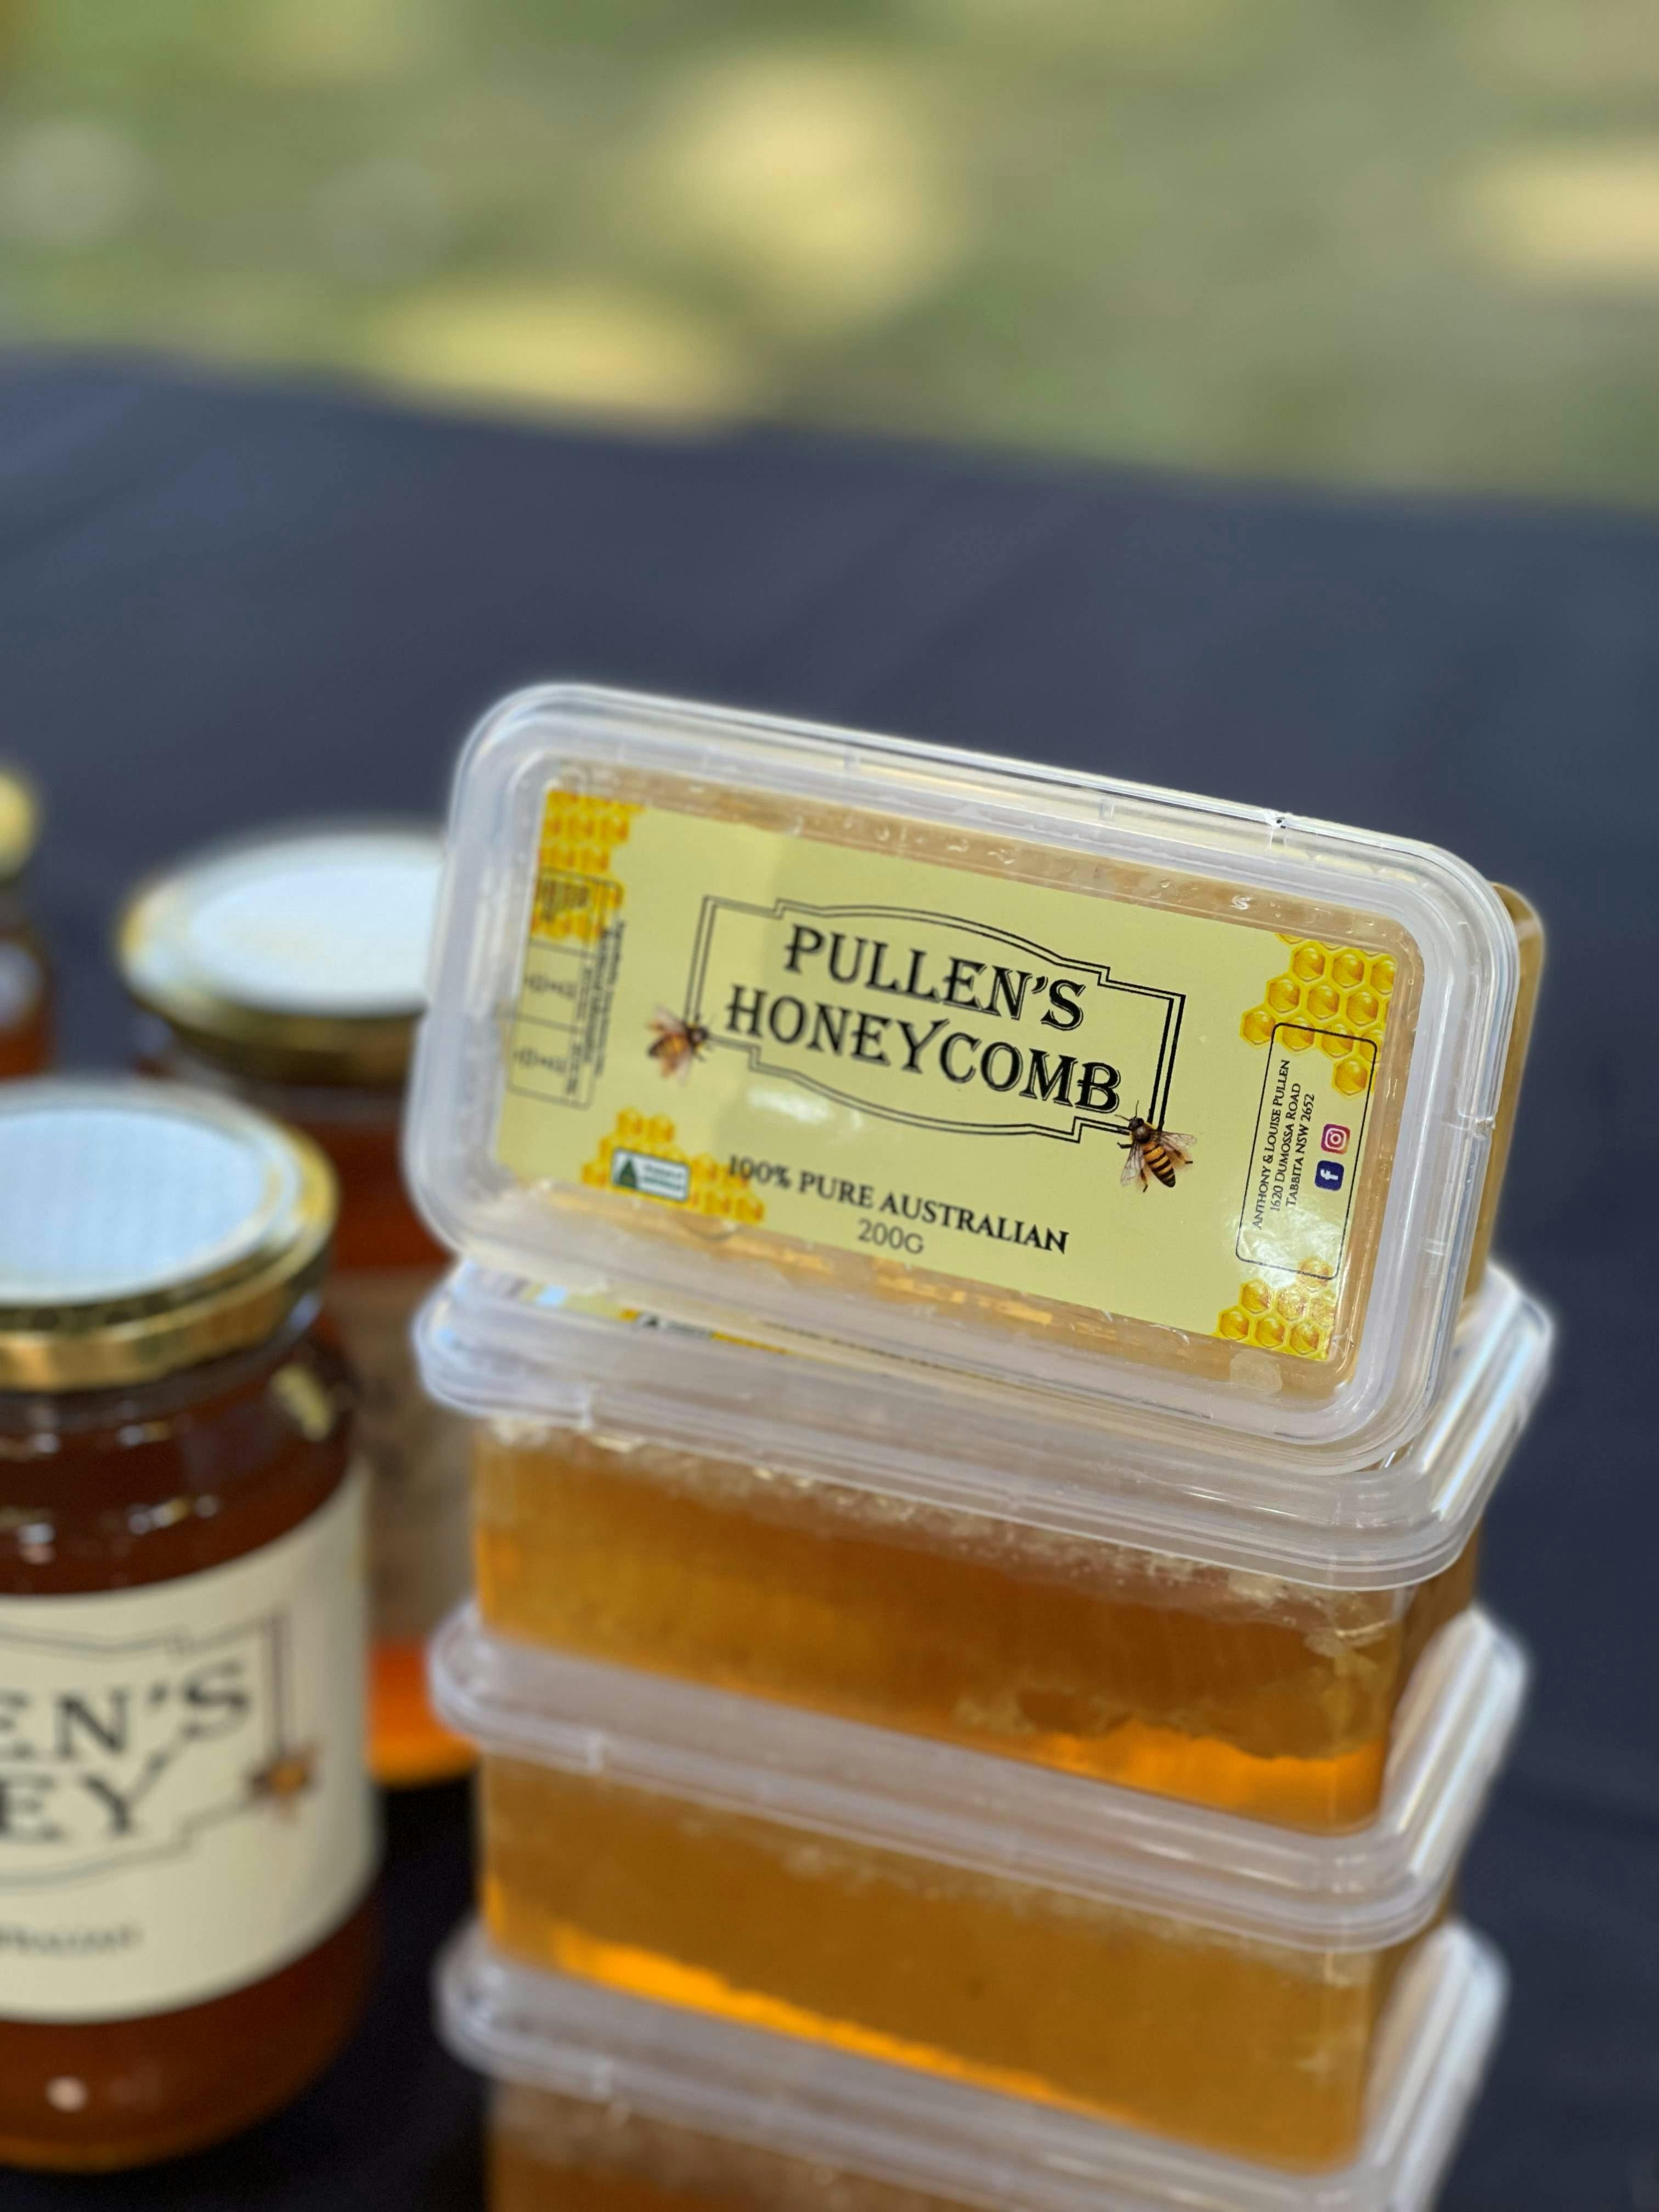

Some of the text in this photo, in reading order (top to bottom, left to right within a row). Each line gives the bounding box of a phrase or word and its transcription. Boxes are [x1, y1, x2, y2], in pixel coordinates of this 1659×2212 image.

[783, 924, 1086, 1031] PULLEN'S
[725, 985, 1122, 1114] HONEYCOMB
[1252, 1059, 1290, 1229] ANTHONY & LOUISE PULLEN
[1269, 1083, 1301, 1212] 1620 DUMOSSA ROAD
[1285, 1093, 1315, 1207] TABBITA NSW 2652
[728, 1155, 792, 1189] 100%
[799, 1170, 874, 1209] PURE
[880, 1193, 1070, 1255] AUSTRALIAN
[857, 1218, 924, 1255] 200G
